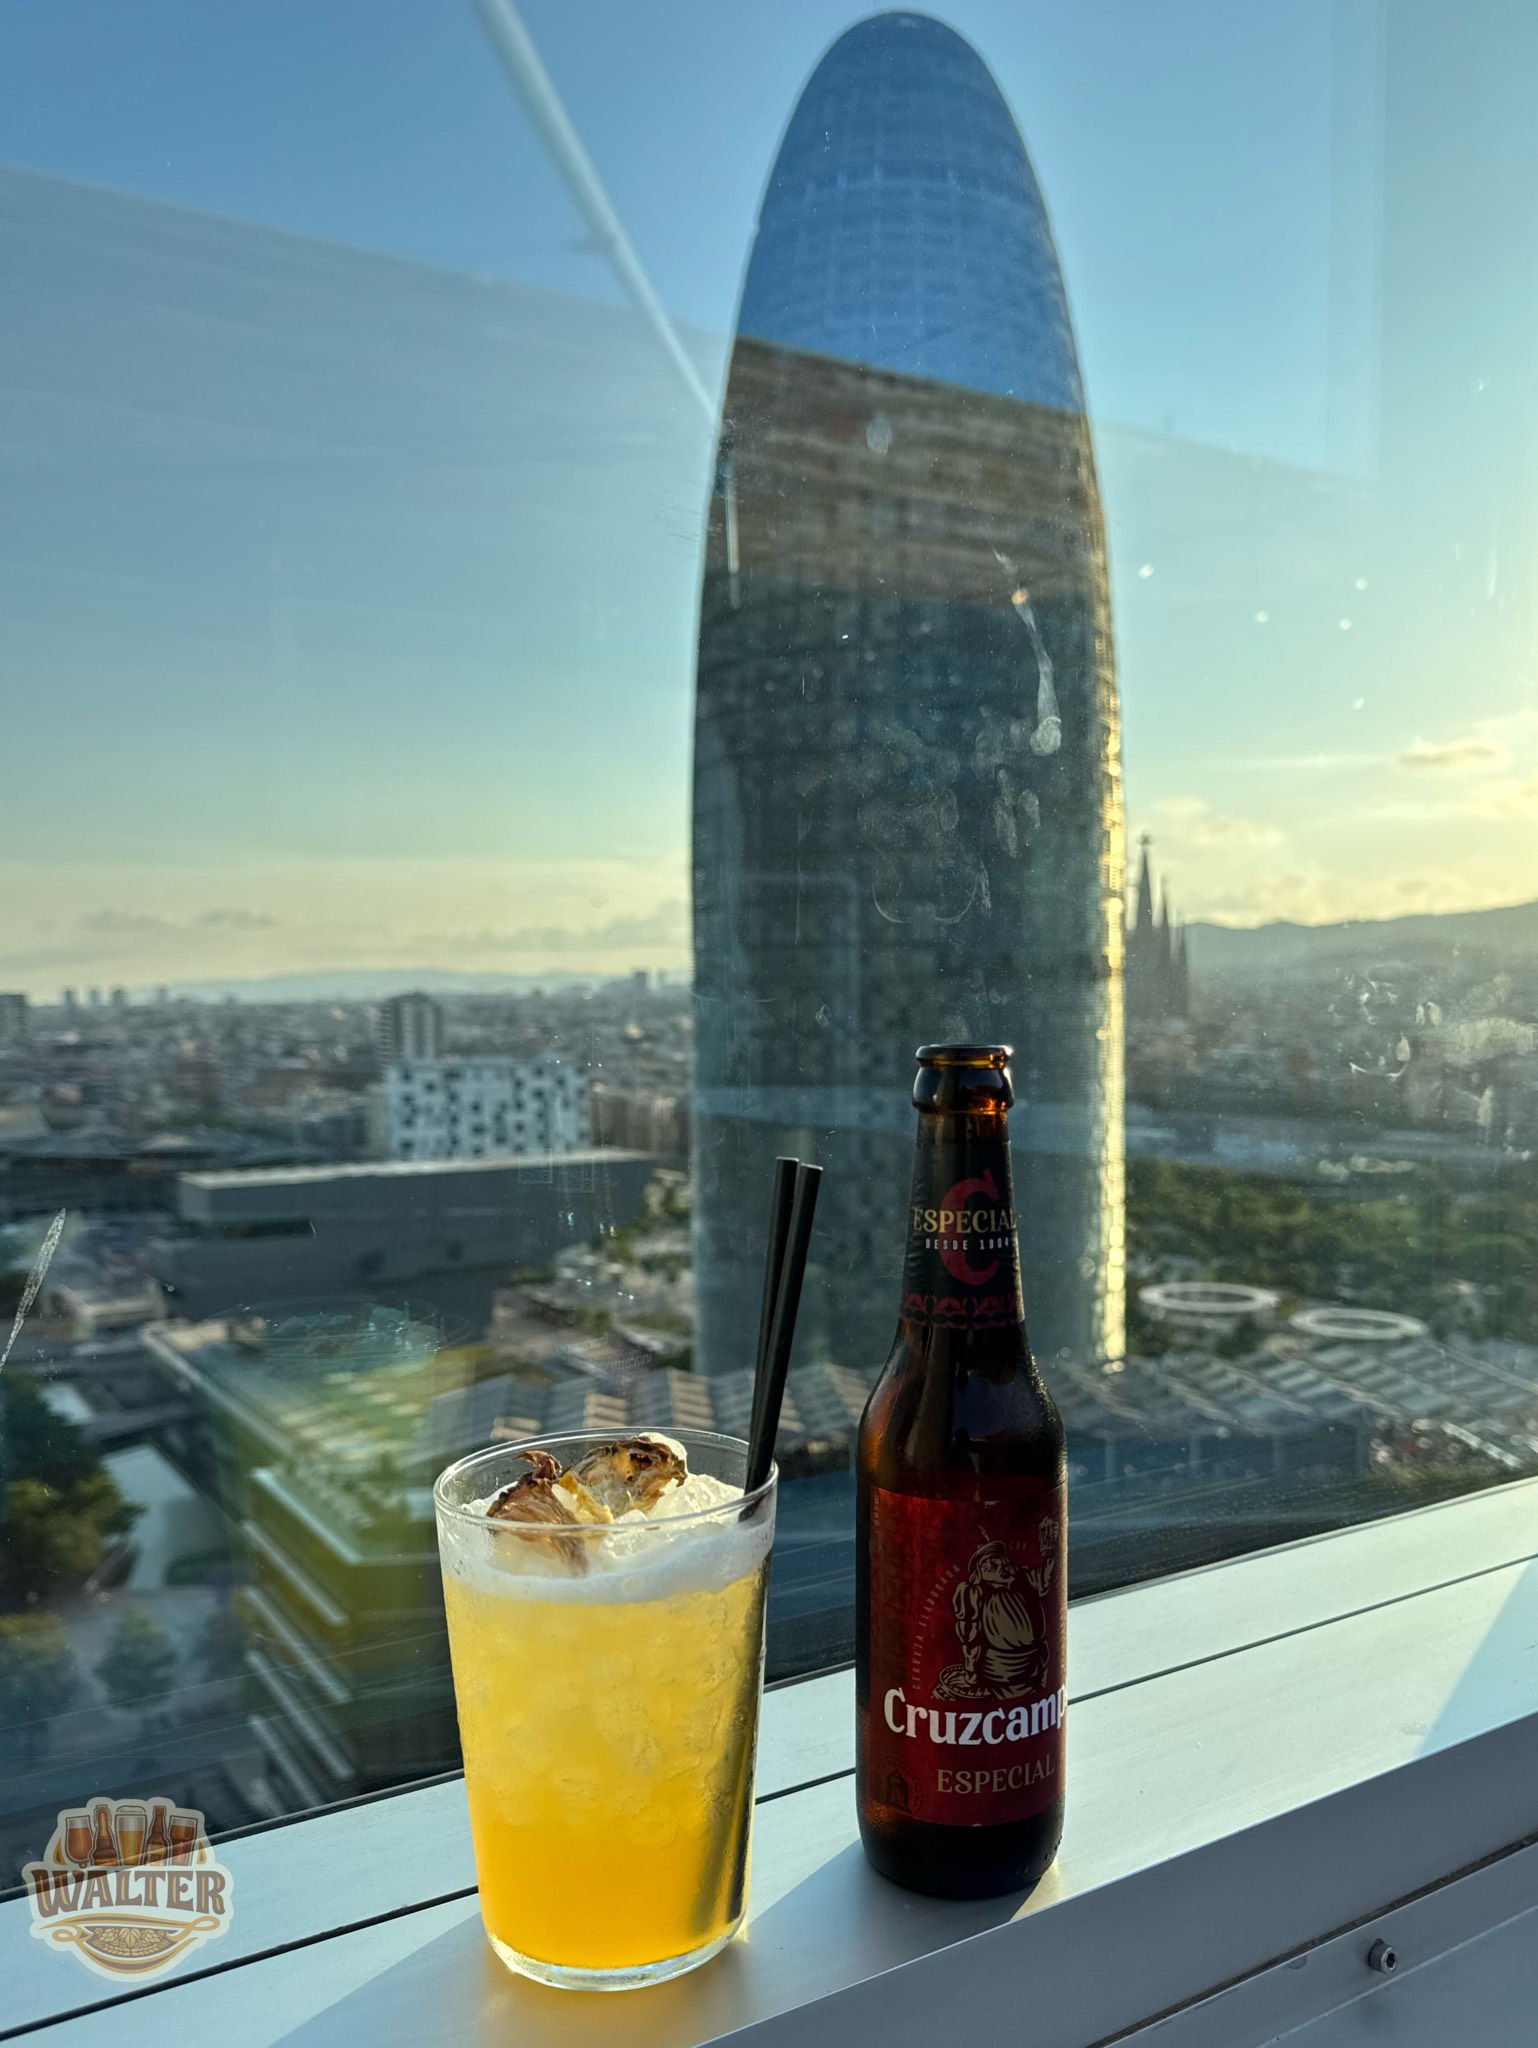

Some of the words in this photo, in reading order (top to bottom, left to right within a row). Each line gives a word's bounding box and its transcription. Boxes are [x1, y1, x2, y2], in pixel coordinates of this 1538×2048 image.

[912, 1207, 1016, 1233] ESPECIAL
[925, 1238, 968, 1250] DESDE
[918, 1564, 960, 1627] ELABORADA
[912, 1635, 925, 1690] CERVEZA
[884, 1684, 1067, 1745] Cruzcamp
[937, 1753, 1055, 1794] ESPECIAL
